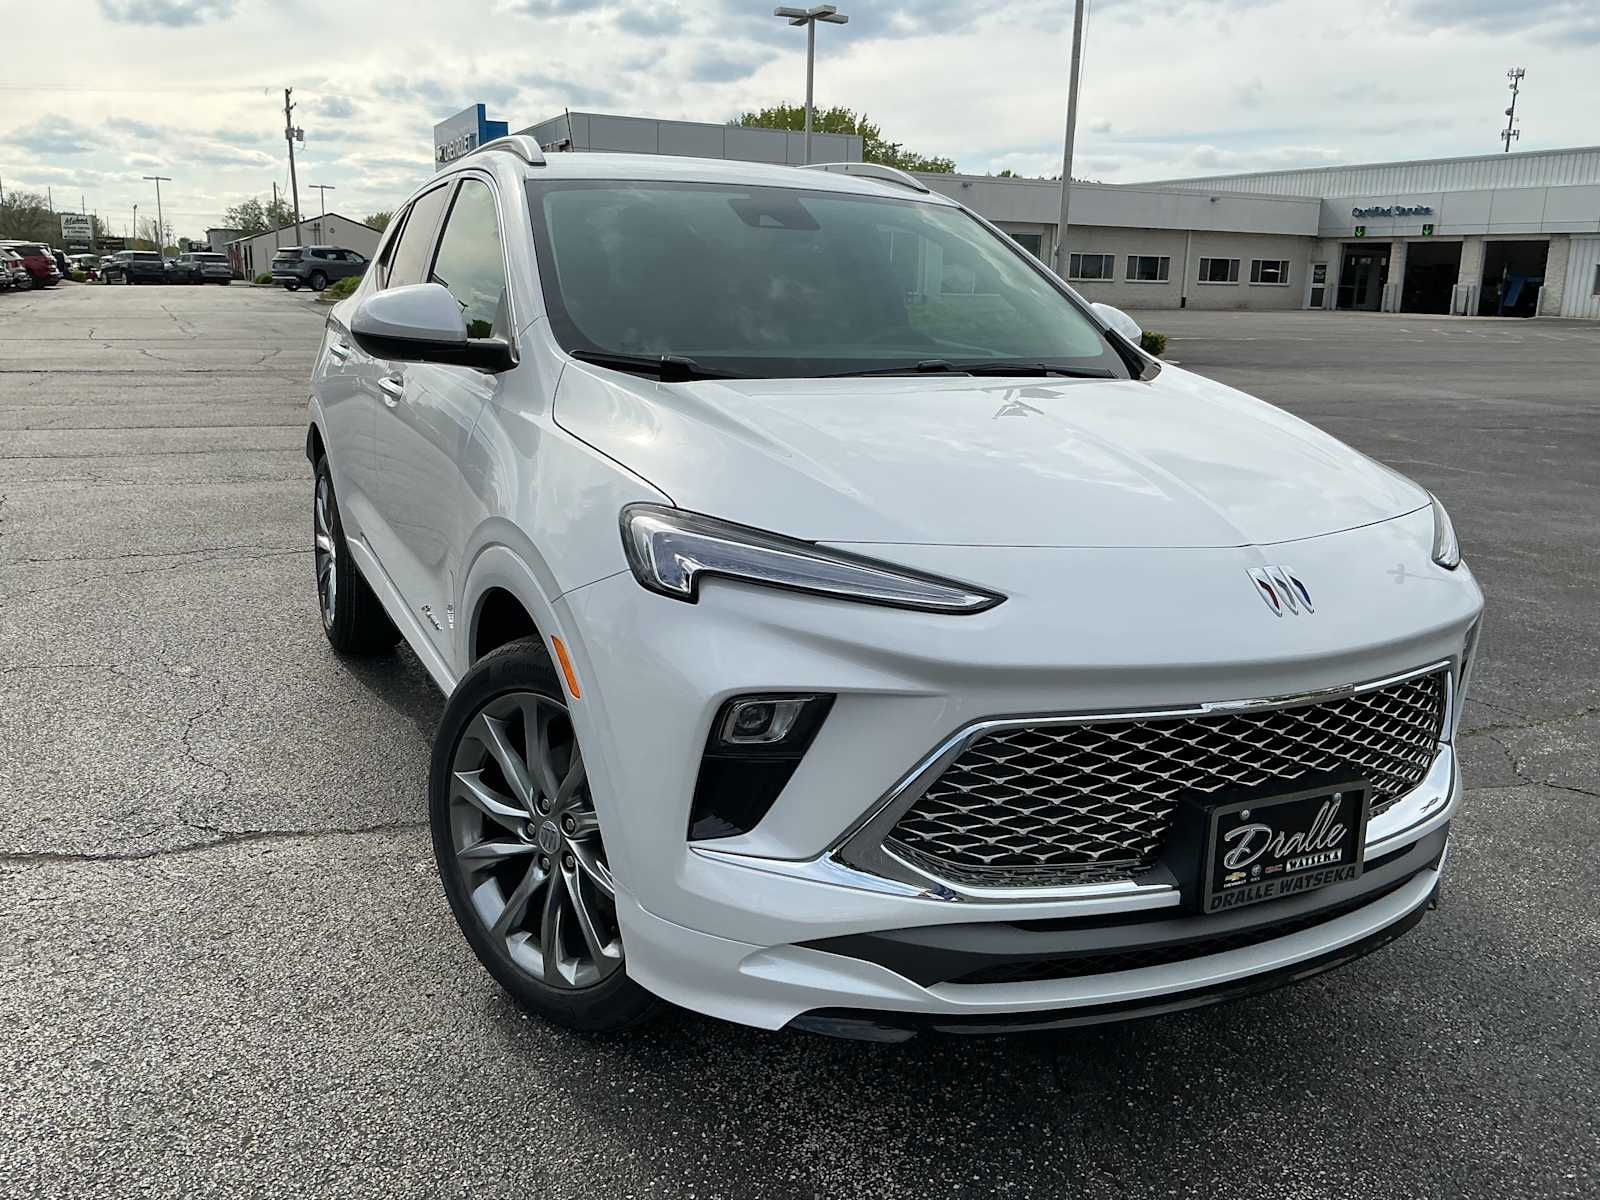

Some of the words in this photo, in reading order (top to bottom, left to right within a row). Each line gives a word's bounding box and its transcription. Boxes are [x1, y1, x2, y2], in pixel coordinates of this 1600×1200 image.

[1224, 799, 1348, 870] Dralle
[1288, 850, 1341, 871] WATSEKA
[1210, 883, 1274, 910] DRALLE
[1280, 866, 1356, 893] WATSEKA
